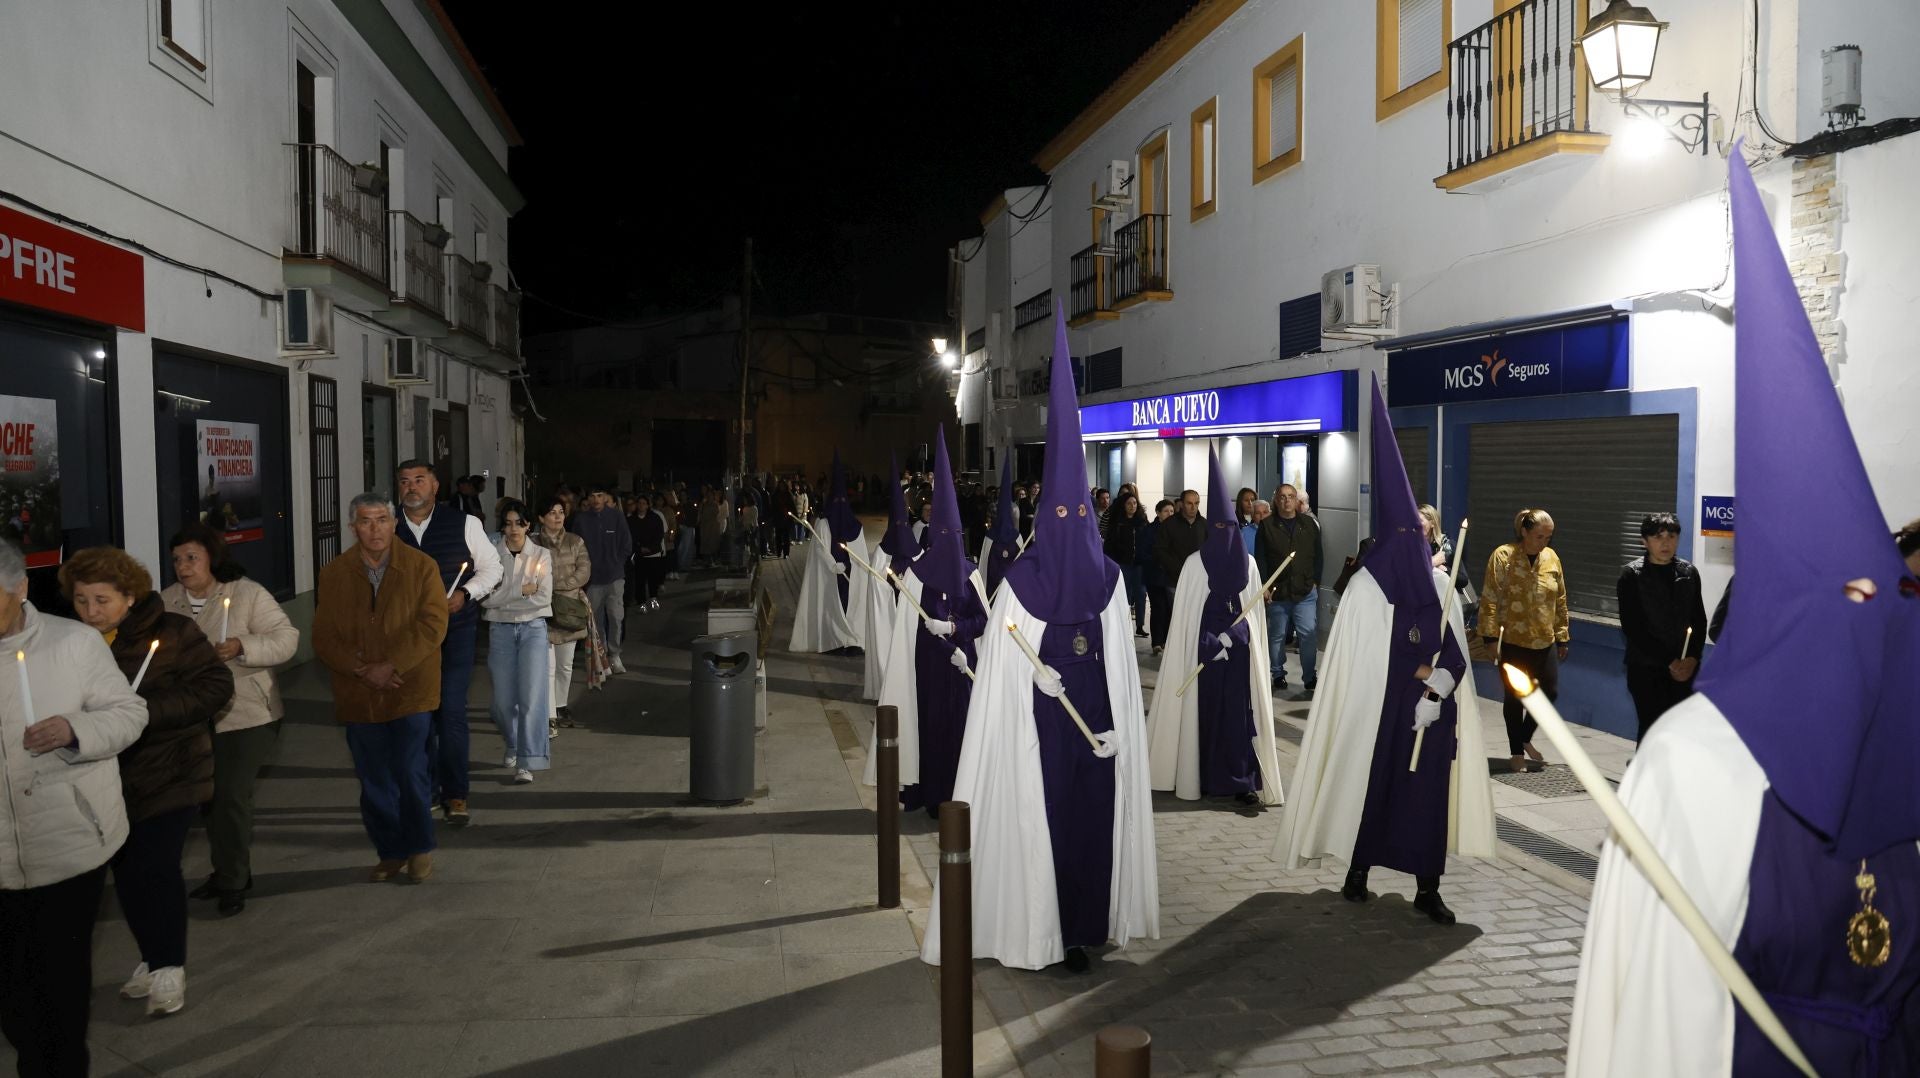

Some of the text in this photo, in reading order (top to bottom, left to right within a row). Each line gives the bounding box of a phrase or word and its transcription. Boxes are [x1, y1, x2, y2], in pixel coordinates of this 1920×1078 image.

[1444, 362, 1550, 390] MGS Seguros
[1132, 391, 1219, 426] BANCA PUEYO
[206, 434, 253, 457] PLANIFICACIÓN
[217, 458, 253, 477] FINANCIERA
[1705, 506, 1734, 520] MGS
